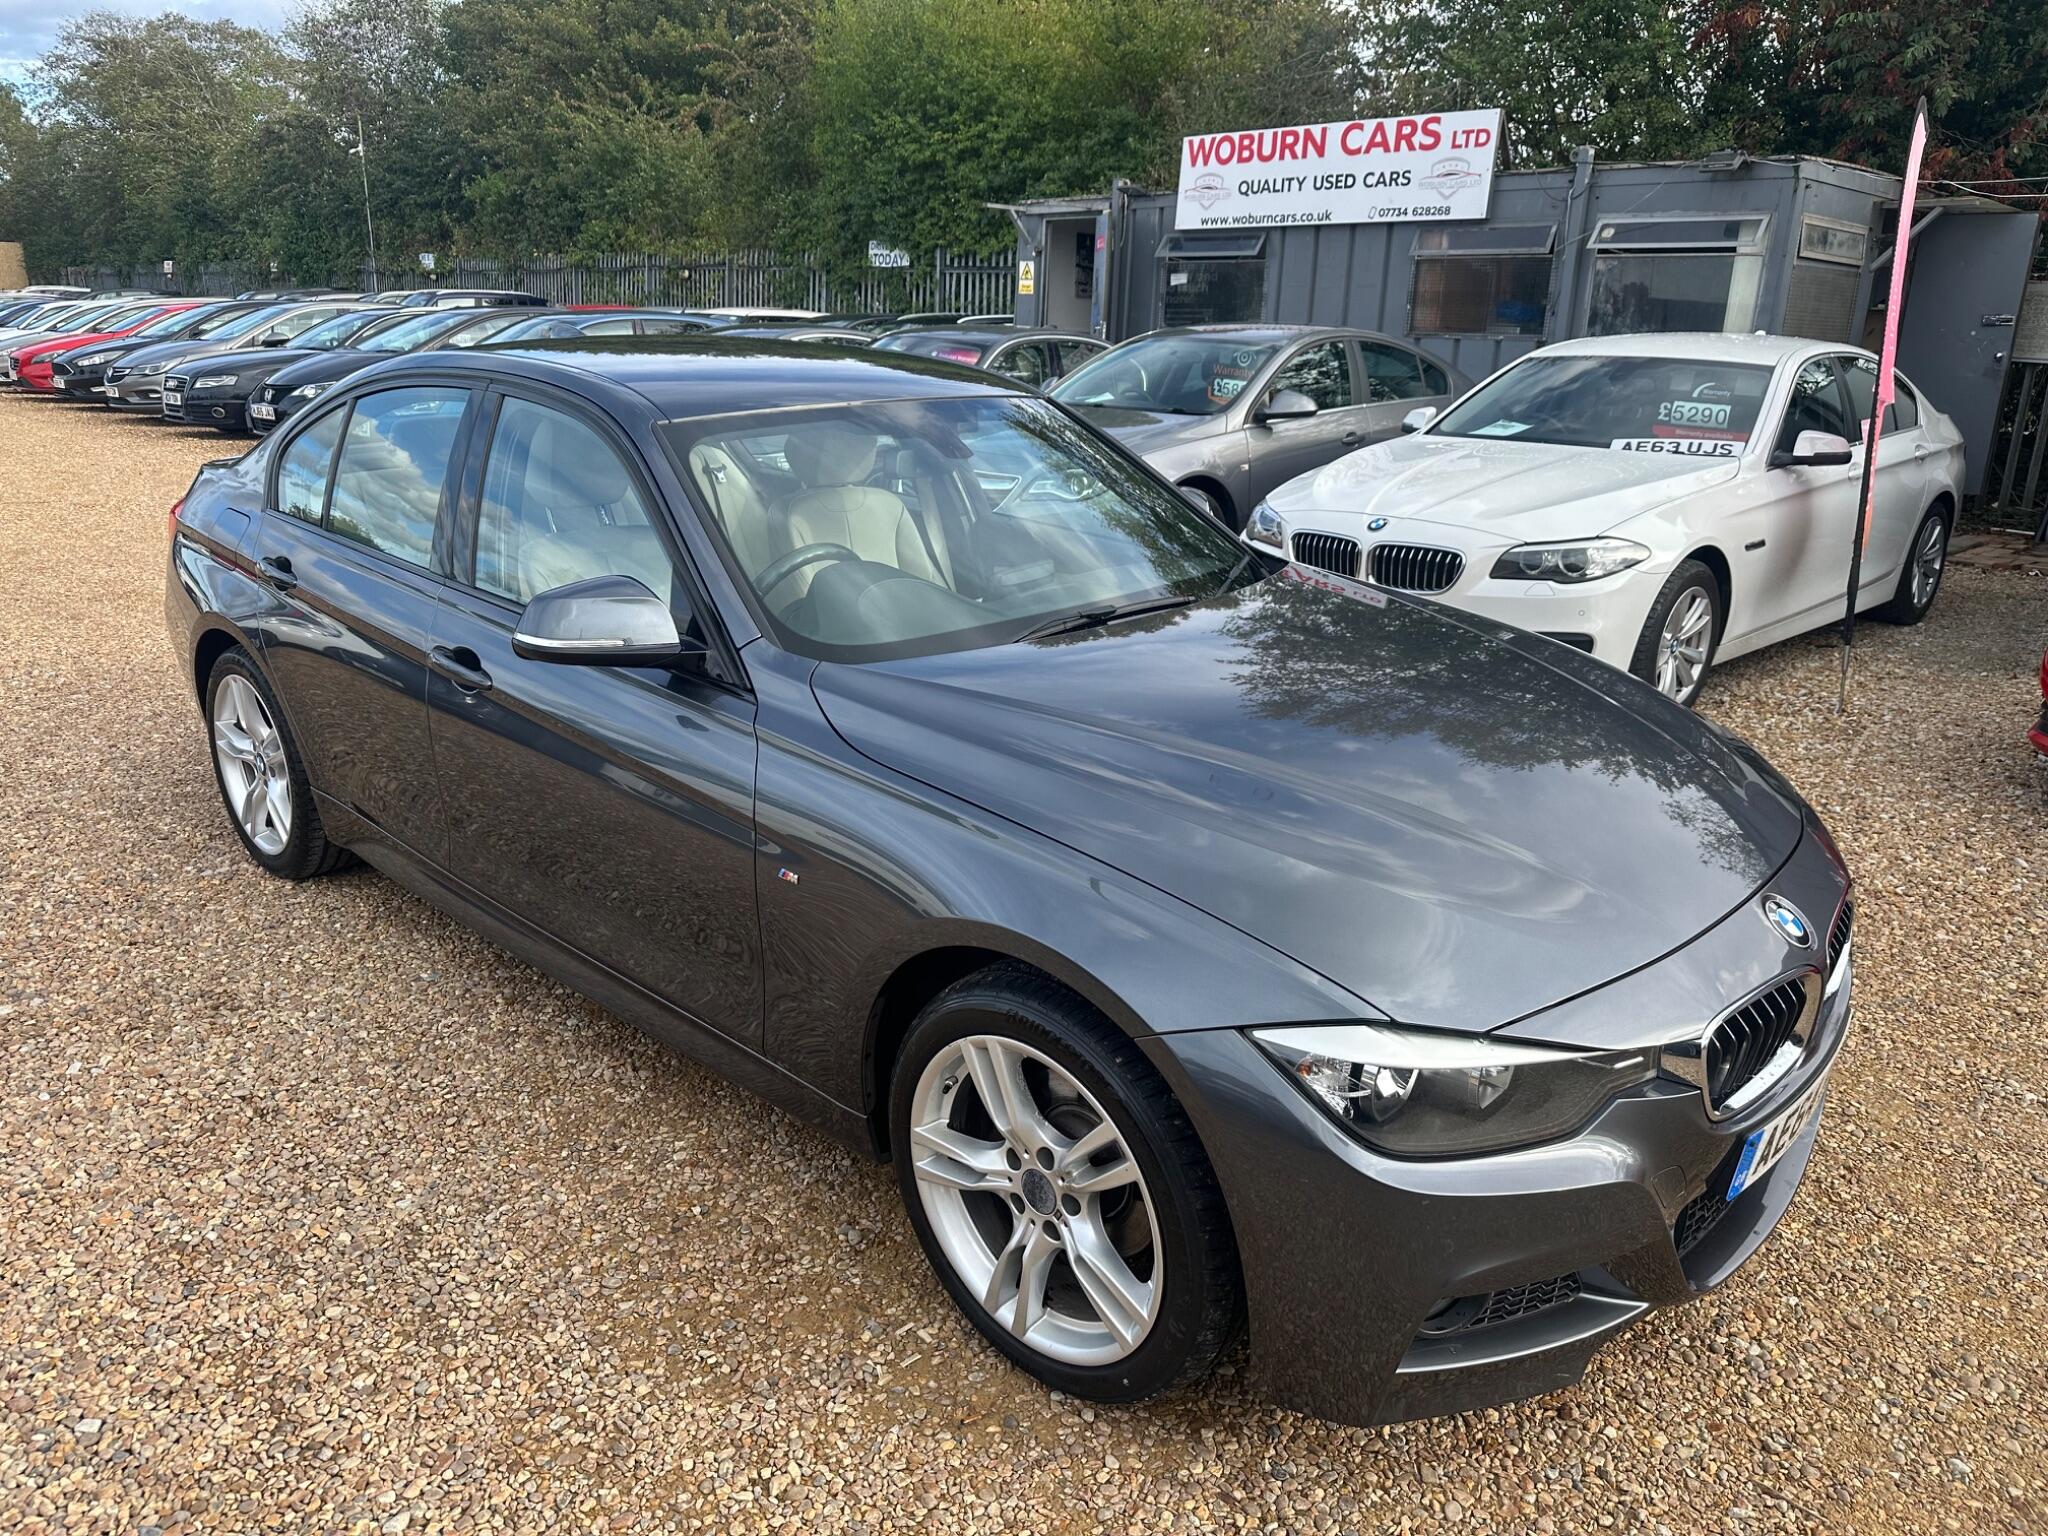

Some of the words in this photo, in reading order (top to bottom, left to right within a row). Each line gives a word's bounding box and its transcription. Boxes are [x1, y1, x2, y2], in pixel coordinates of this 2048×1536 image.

[1187, 126, 1328, 168] WOBURN
[1340, 115, 1442, 156] CARS
[1450, 128, 1491, 149] LTD
[1238, 176, 1307, 197] QUALITY
[1313, 173, 1356, 191] USED
[1363, 170, 1411, 188] CARS
[1200, 209, 1332, 226] www.woburncars.co.uk
[1378, 207, 1408, 218] 07734
[1411, 205, 1451, 216] 628268
[873, 253, 905, 267] TODAY
[1657, 402, 1728, 425] £5290
[1621, 441, 1681, 453] AE63
[1686, 442, 1735, 455] UJS
